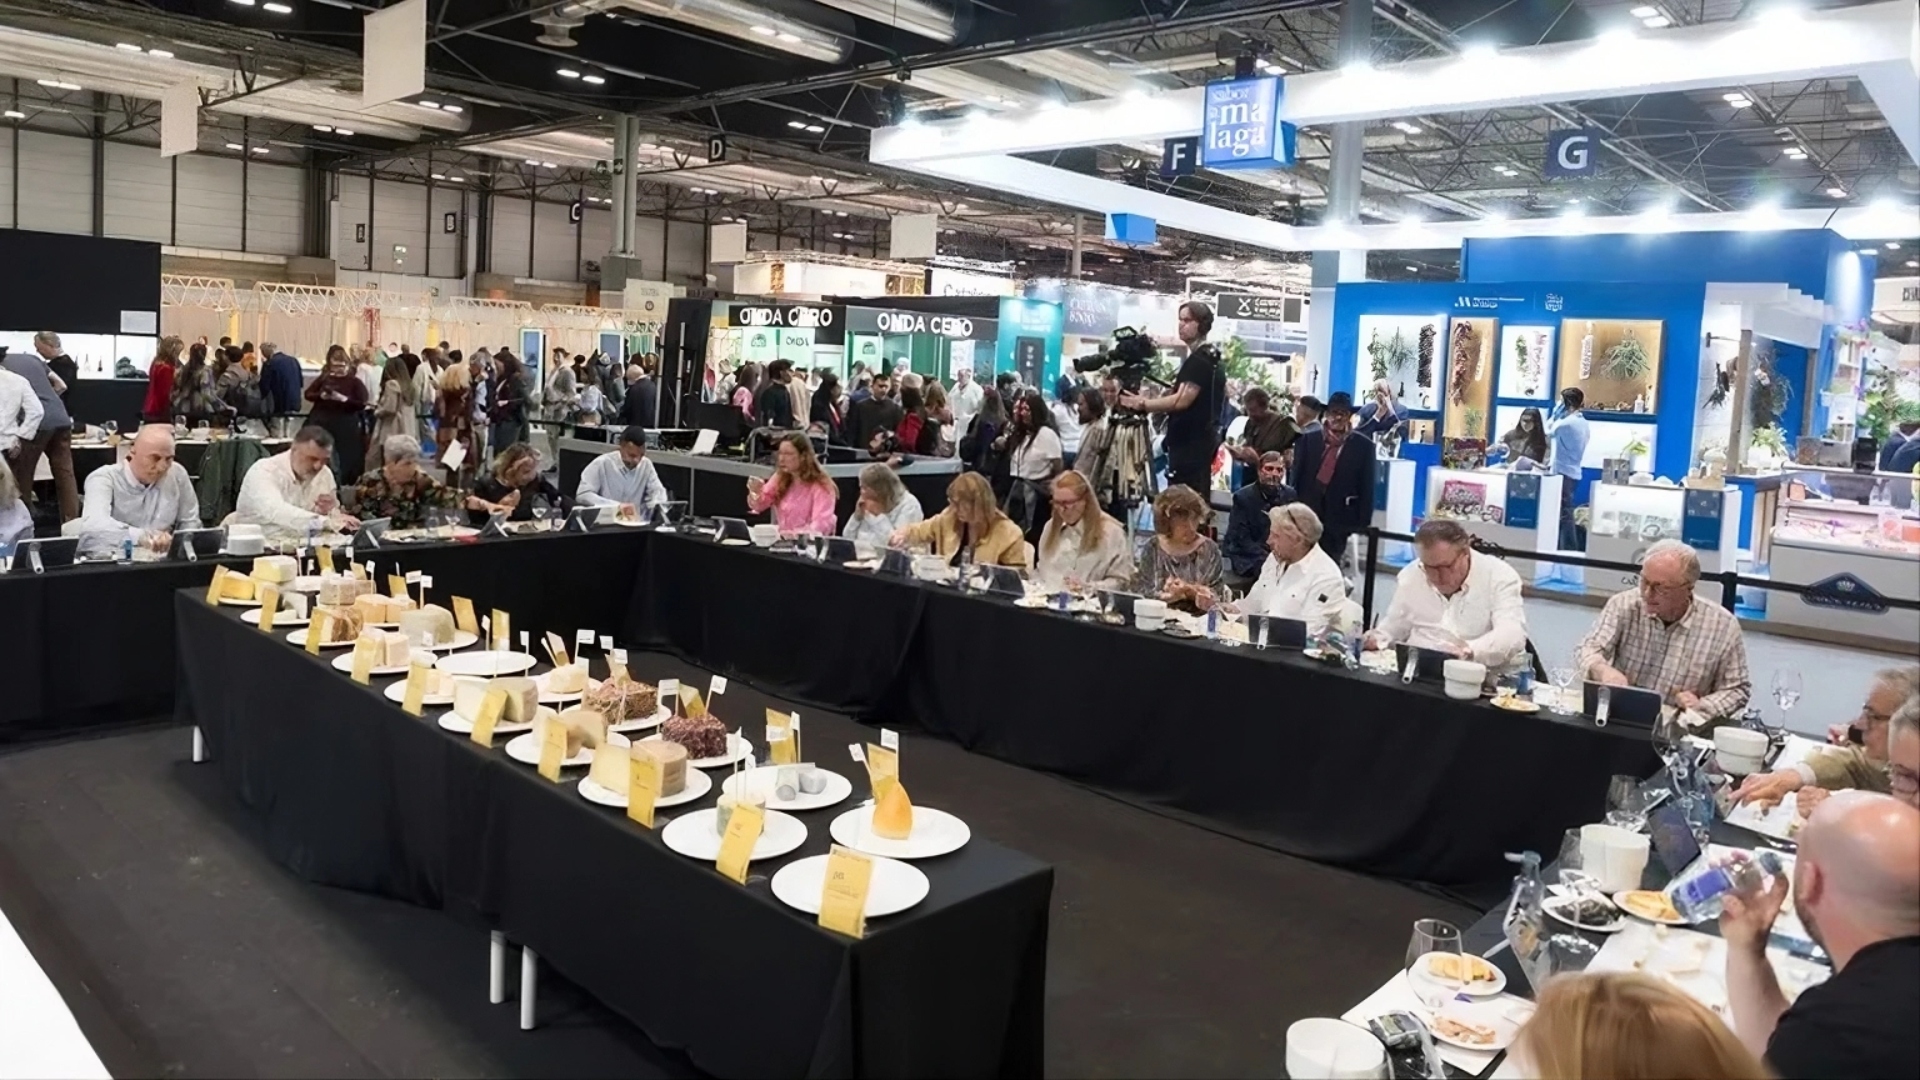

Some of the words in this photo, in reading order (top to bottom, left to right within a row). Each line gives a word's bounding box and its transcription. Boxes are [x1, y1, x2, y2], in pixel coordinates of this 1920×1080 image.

[711, 139, 723, 159] D
[1209, 121, 1266, 157] laga
[1558, 136, 1589, 170] G
[1171, 143, 1187, 171] F
